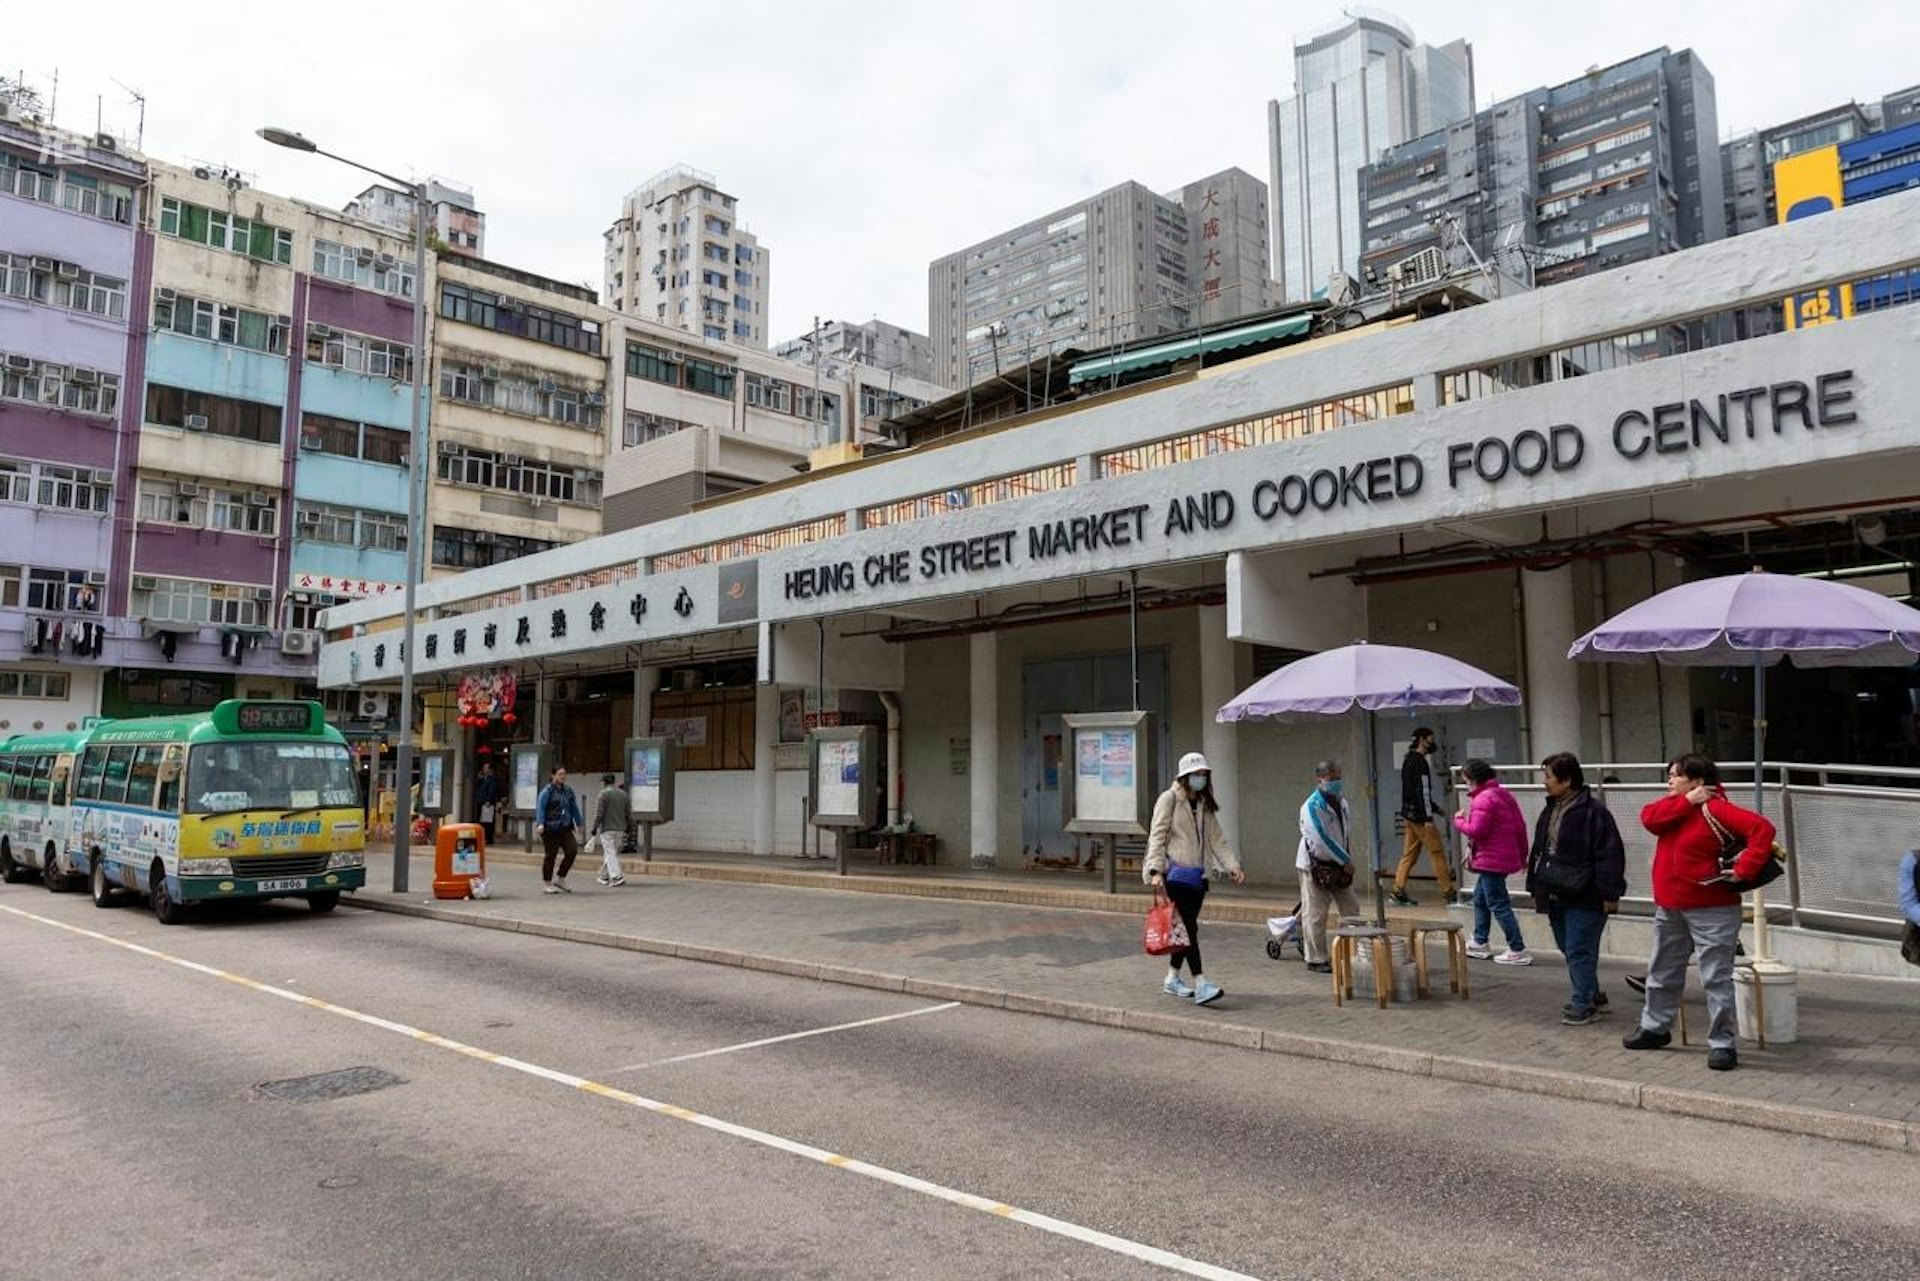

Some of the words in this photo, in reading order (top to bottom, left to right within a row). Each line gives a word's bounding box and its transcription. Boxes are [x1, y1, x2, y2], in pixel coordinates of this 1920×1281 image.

[784, 561, 855, 600] HEUNG
[863, 551, 910, 588] CHE
[920, 530, 1016, 579] STREET
[1029, 504, 1149, 560] MARKET
[1164, 490, 1235, 537] AND
[1252, 454, 1424, 521] COOKED
[1447, 424, 1586, 489] FOOD
[1612, 369, 1858, 462] CENTRE
